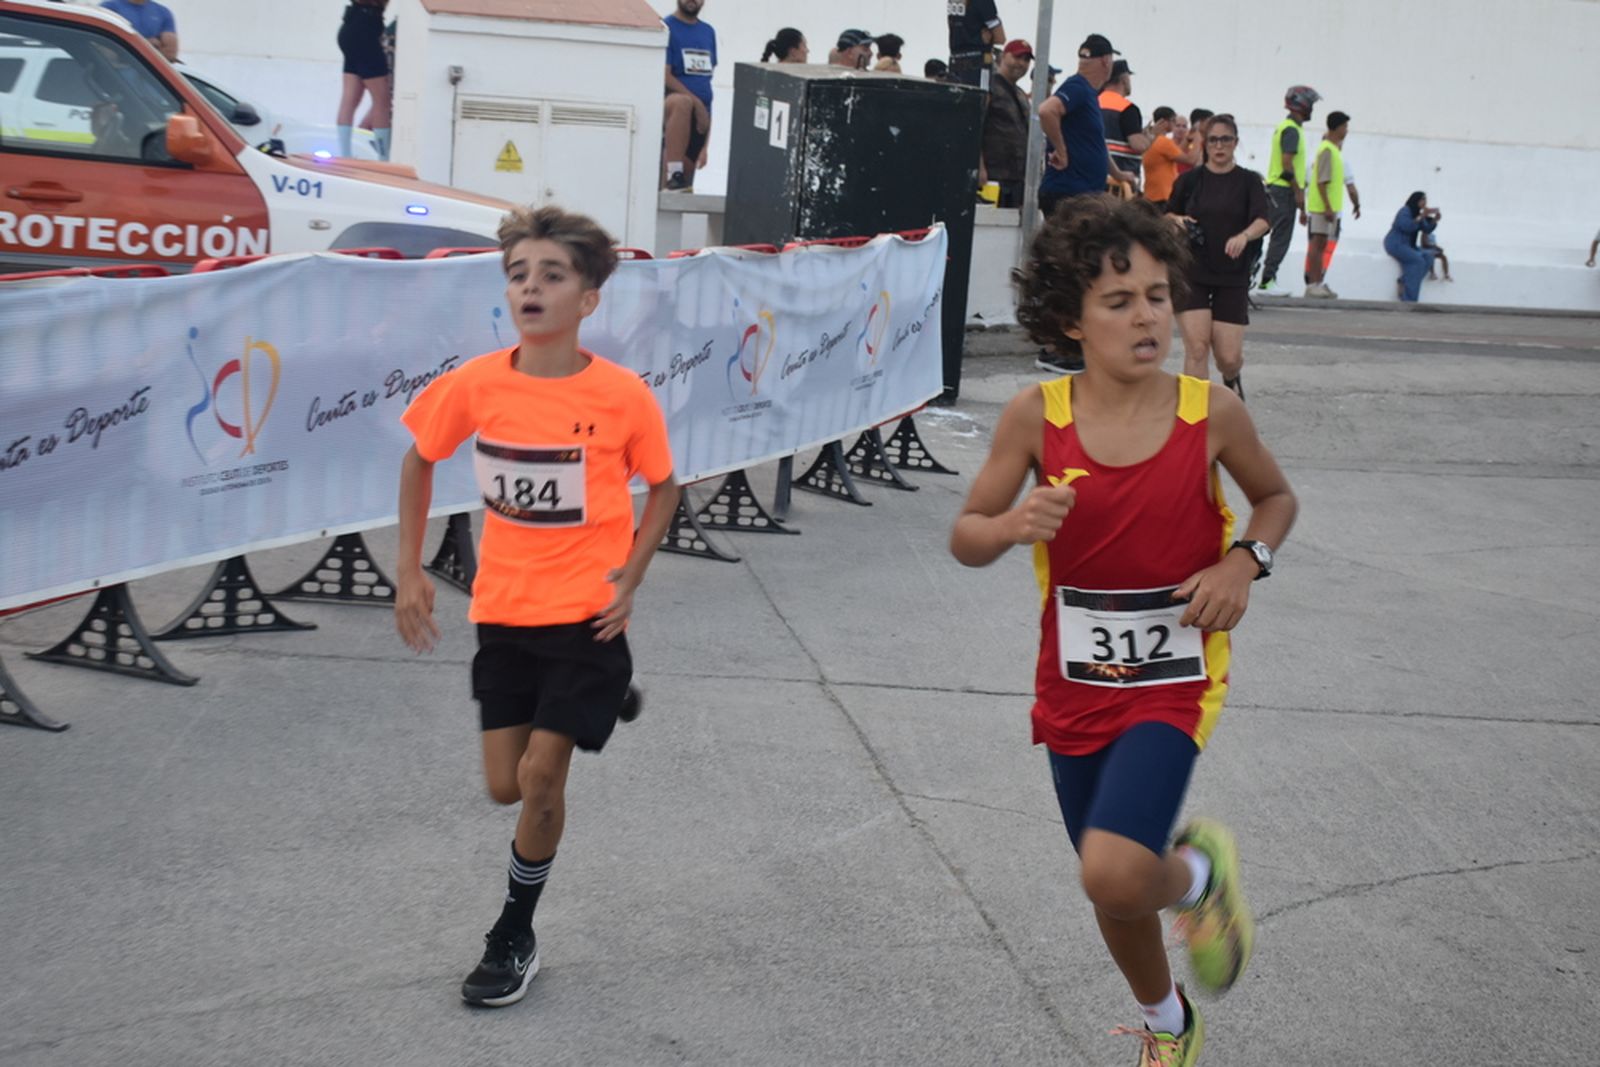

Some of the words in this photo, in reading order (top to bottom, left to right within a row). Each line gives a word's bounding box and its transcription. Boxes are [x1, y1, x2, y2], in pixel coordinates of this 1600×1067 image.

[775, 109, 783, 141] 1
[272, 174, 323, 198] V-01
[0, 212, 268, 257] ROTECCIÓN
[362, 390, 379, 408] es
[38, 434, 60, 456] es
[64, 386, 152, 450] Deporte
[494, 474, 562, 509] 184
[1091, 624, 1174, 664] 312
